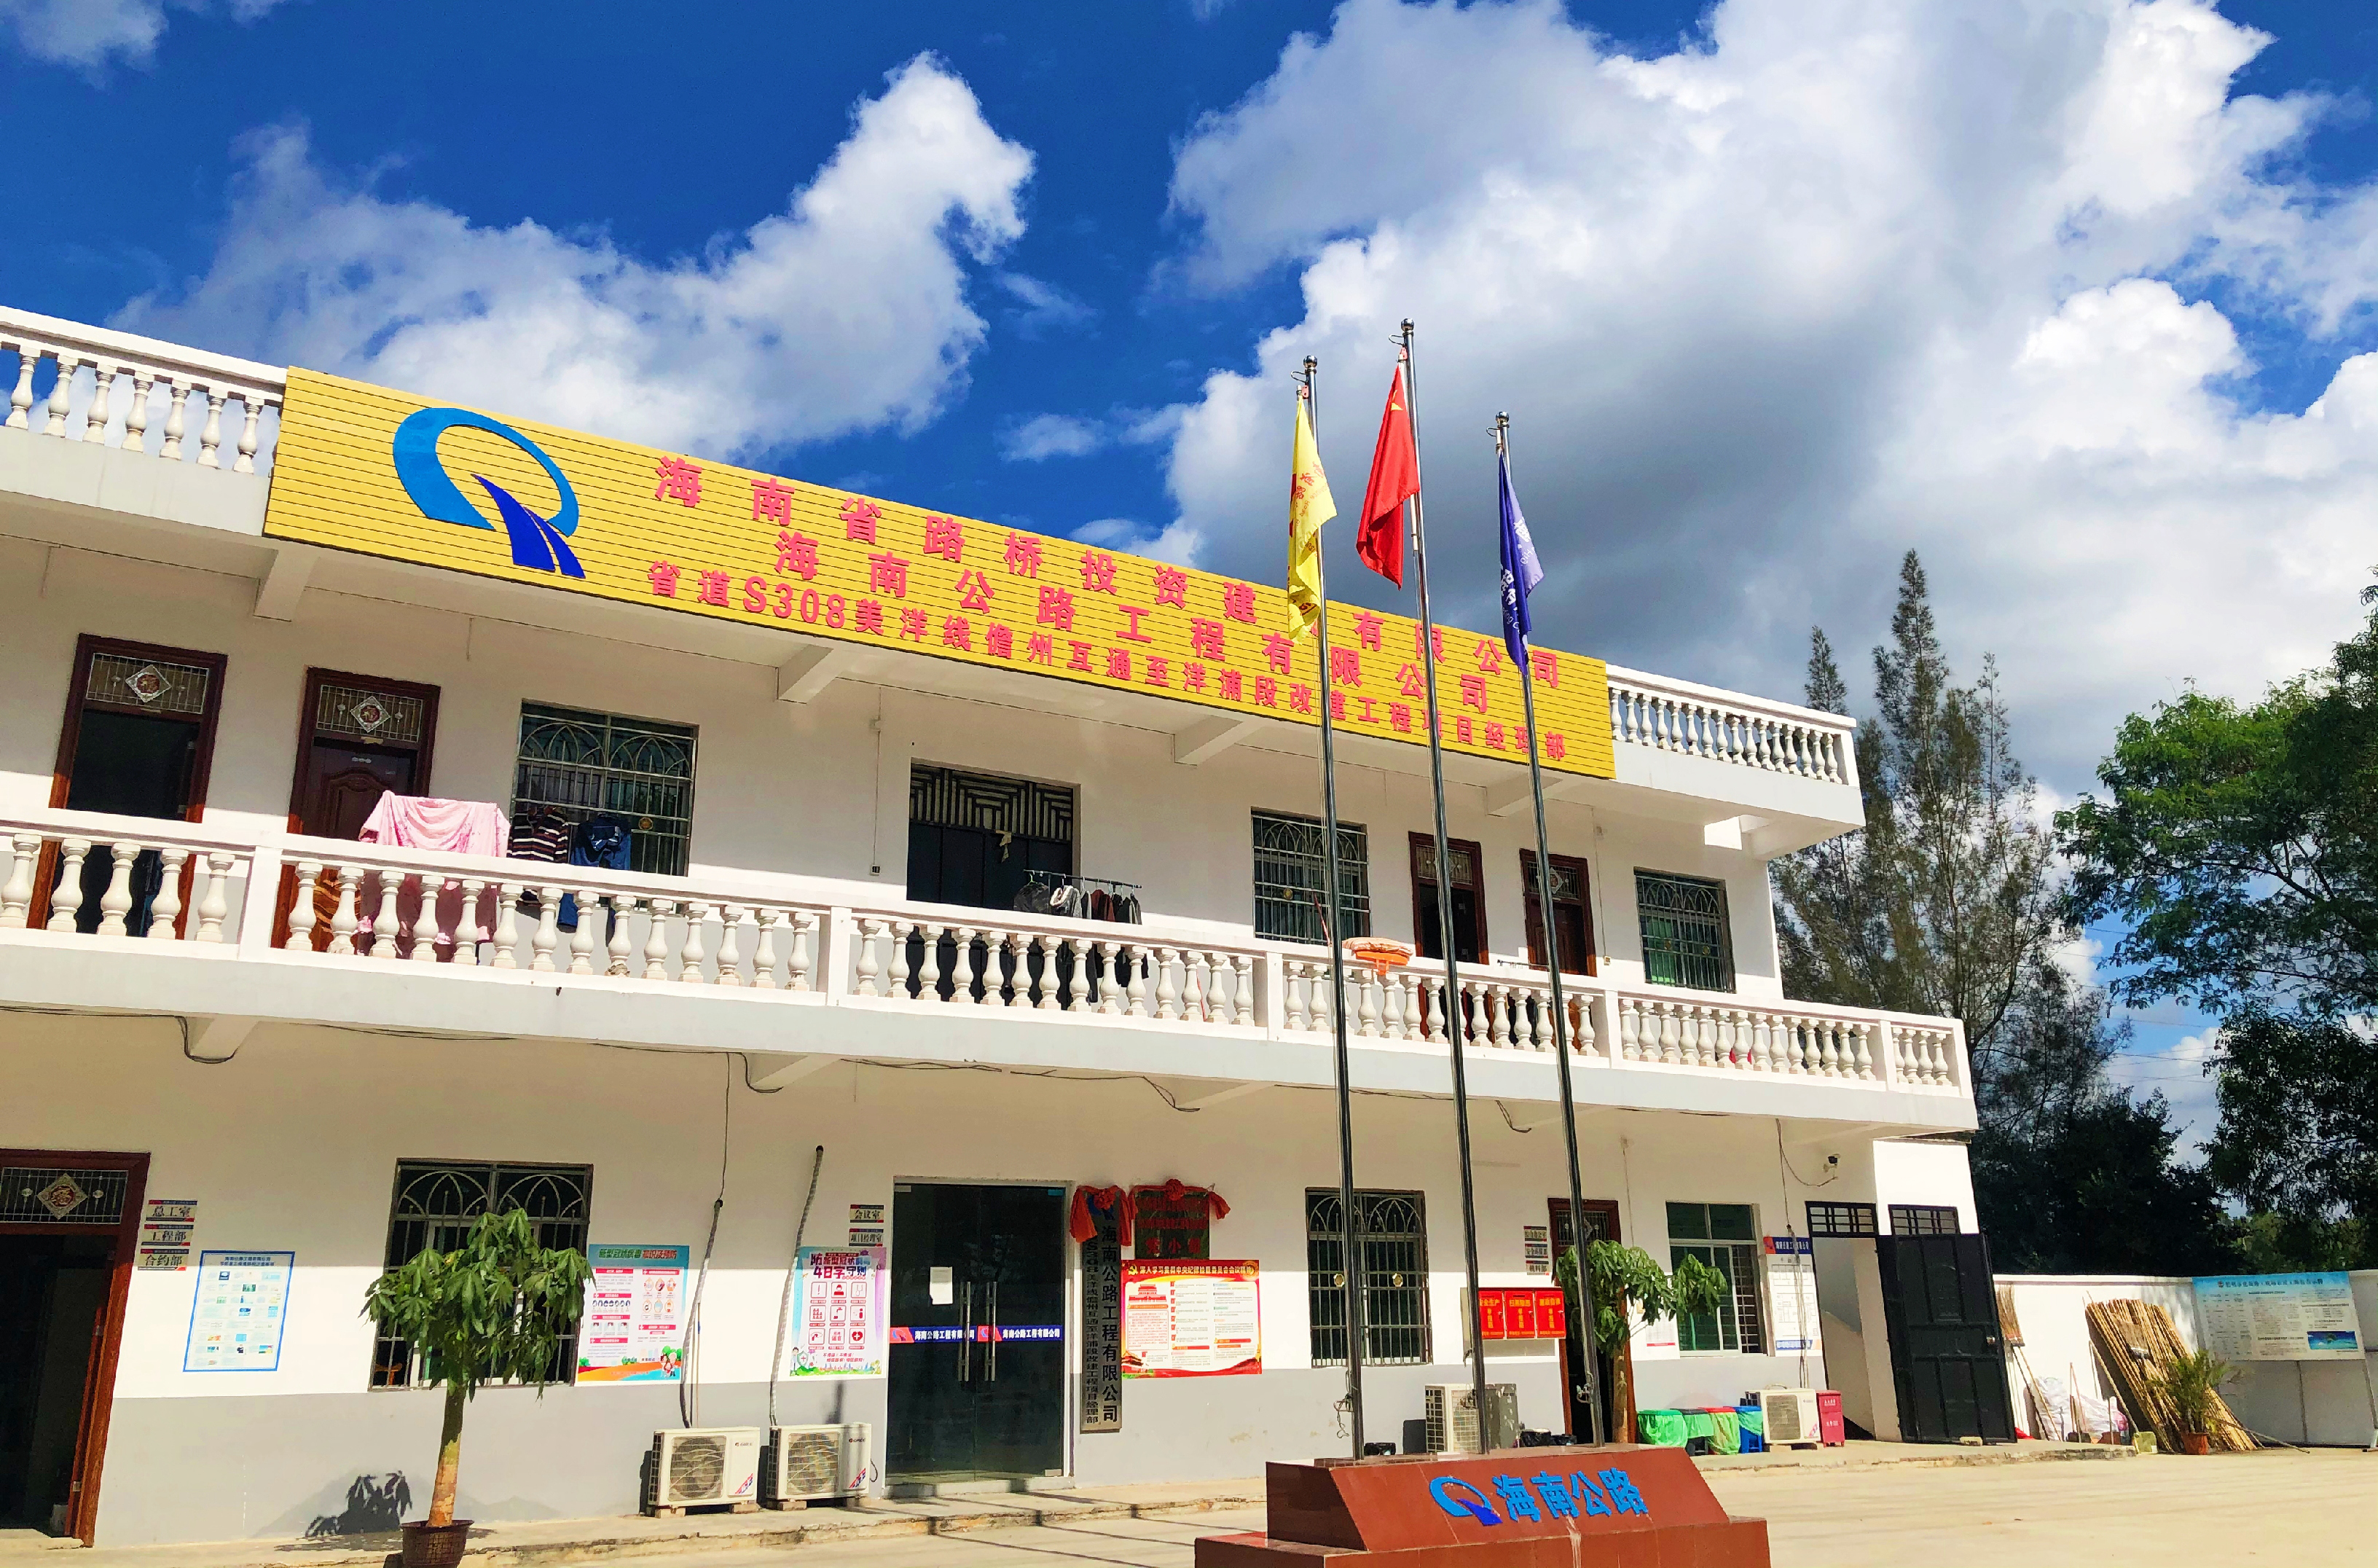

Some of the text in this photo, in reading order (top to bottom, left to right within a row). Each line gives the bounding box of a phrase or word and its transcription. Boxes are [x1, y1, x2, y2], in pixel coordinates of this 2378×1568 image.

[656, 457, 1558, 687] 海南省路桥投资建有限公司
[775, 530, 1488, 713] 海南公路工程有限公司
[152, 1205, 192, 1218] 总工室
[855, 1210, 881, 1220] 会议室
[150, 1230, 187, 1242] 工程部
[850, 1233, 882, 1243] 项目经理室
[145, 1254, 183, 1266] 合约部
[1101, 1225, 1119, 1423] 海南公路工程有限公司
[1002, 1328, 1061, 1339] 海南公路工程有限公司
[1491, 1466, 1649, 1522] 海南公路
